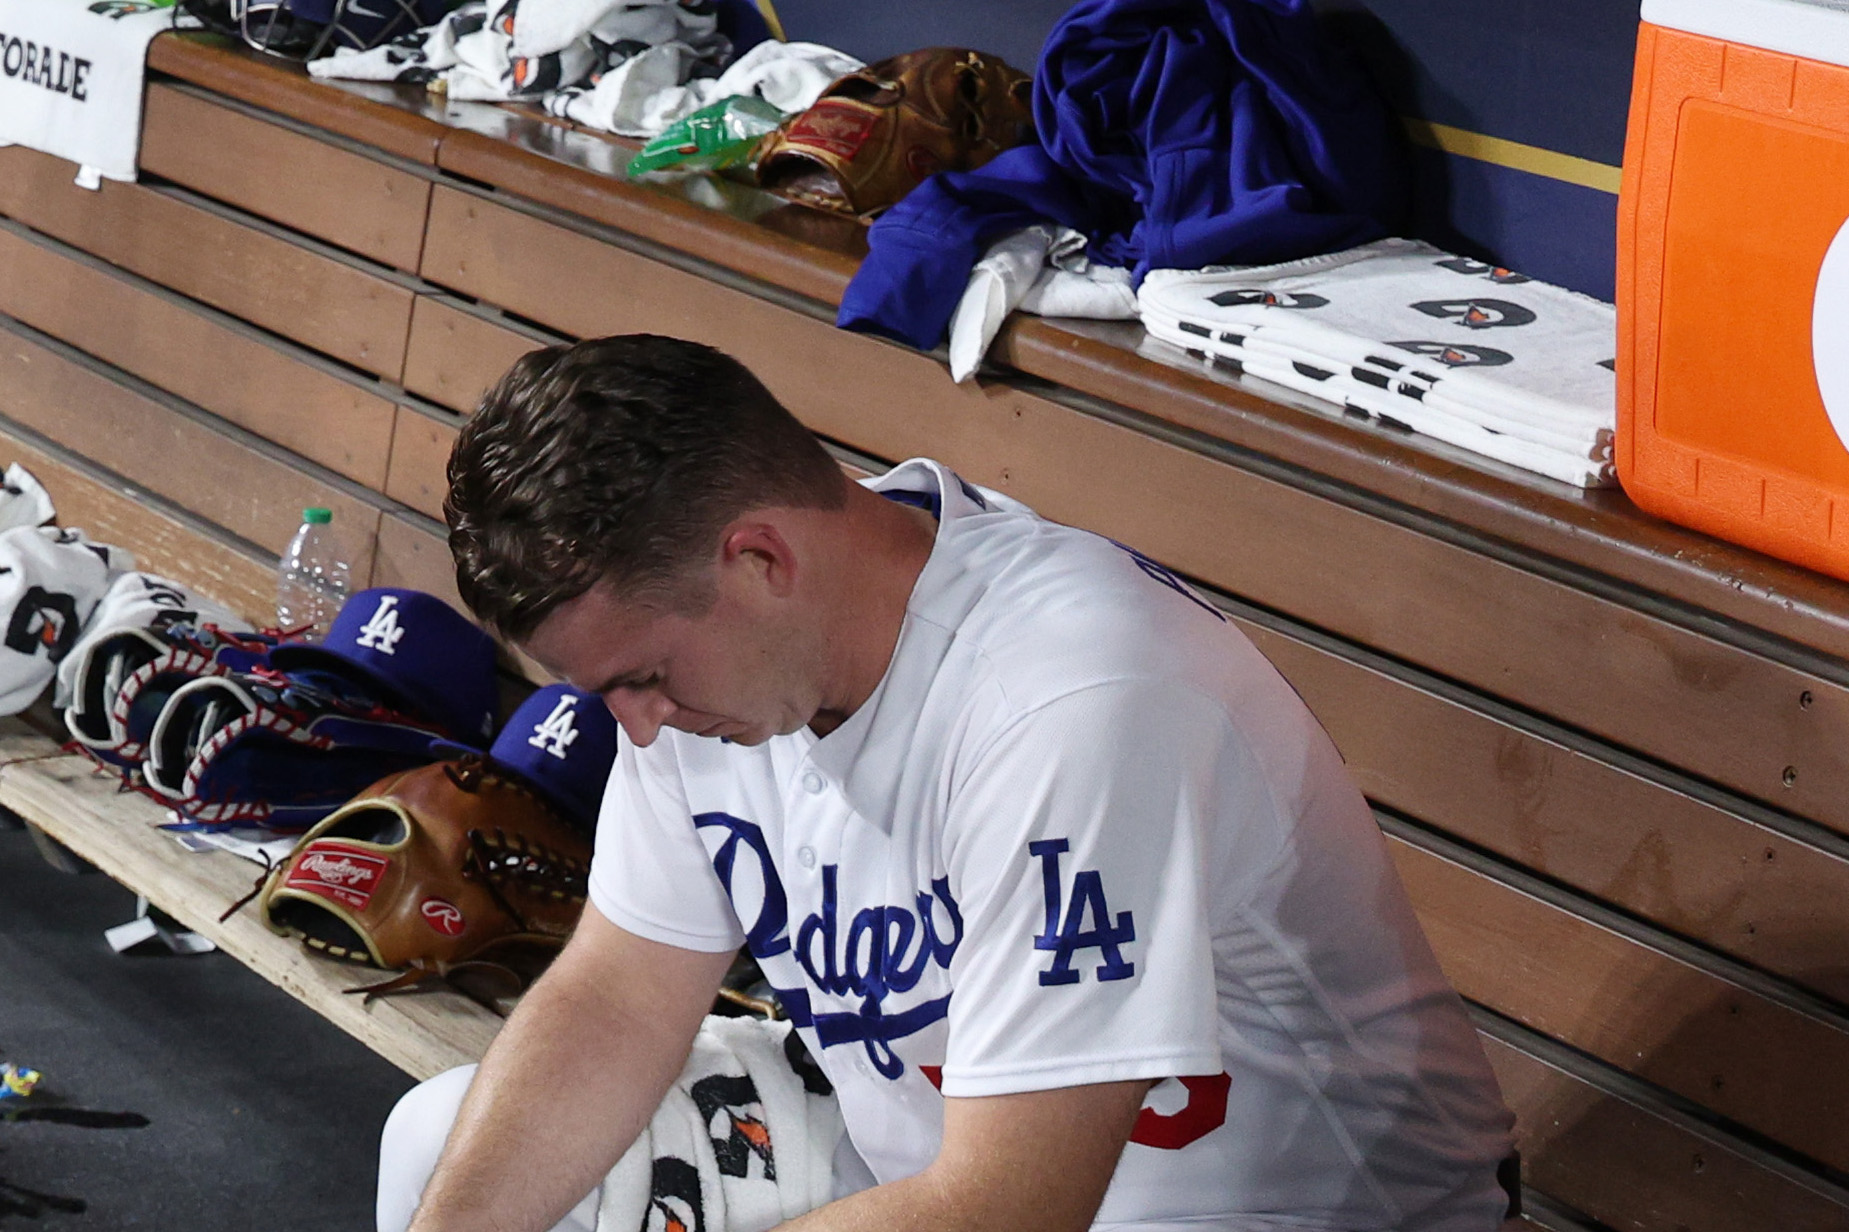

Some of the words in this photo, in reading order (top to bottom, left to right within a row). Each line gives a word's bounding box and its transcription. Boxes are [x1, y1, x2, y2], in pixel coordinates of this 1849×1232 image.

[356, 595, 405, 656] LA
[528, 694, 579, 760] LA
[421, 900, 462, 934] R
[1028, 838, 1136, 987] LA
[691, 811, 964, 1081] Ddges
